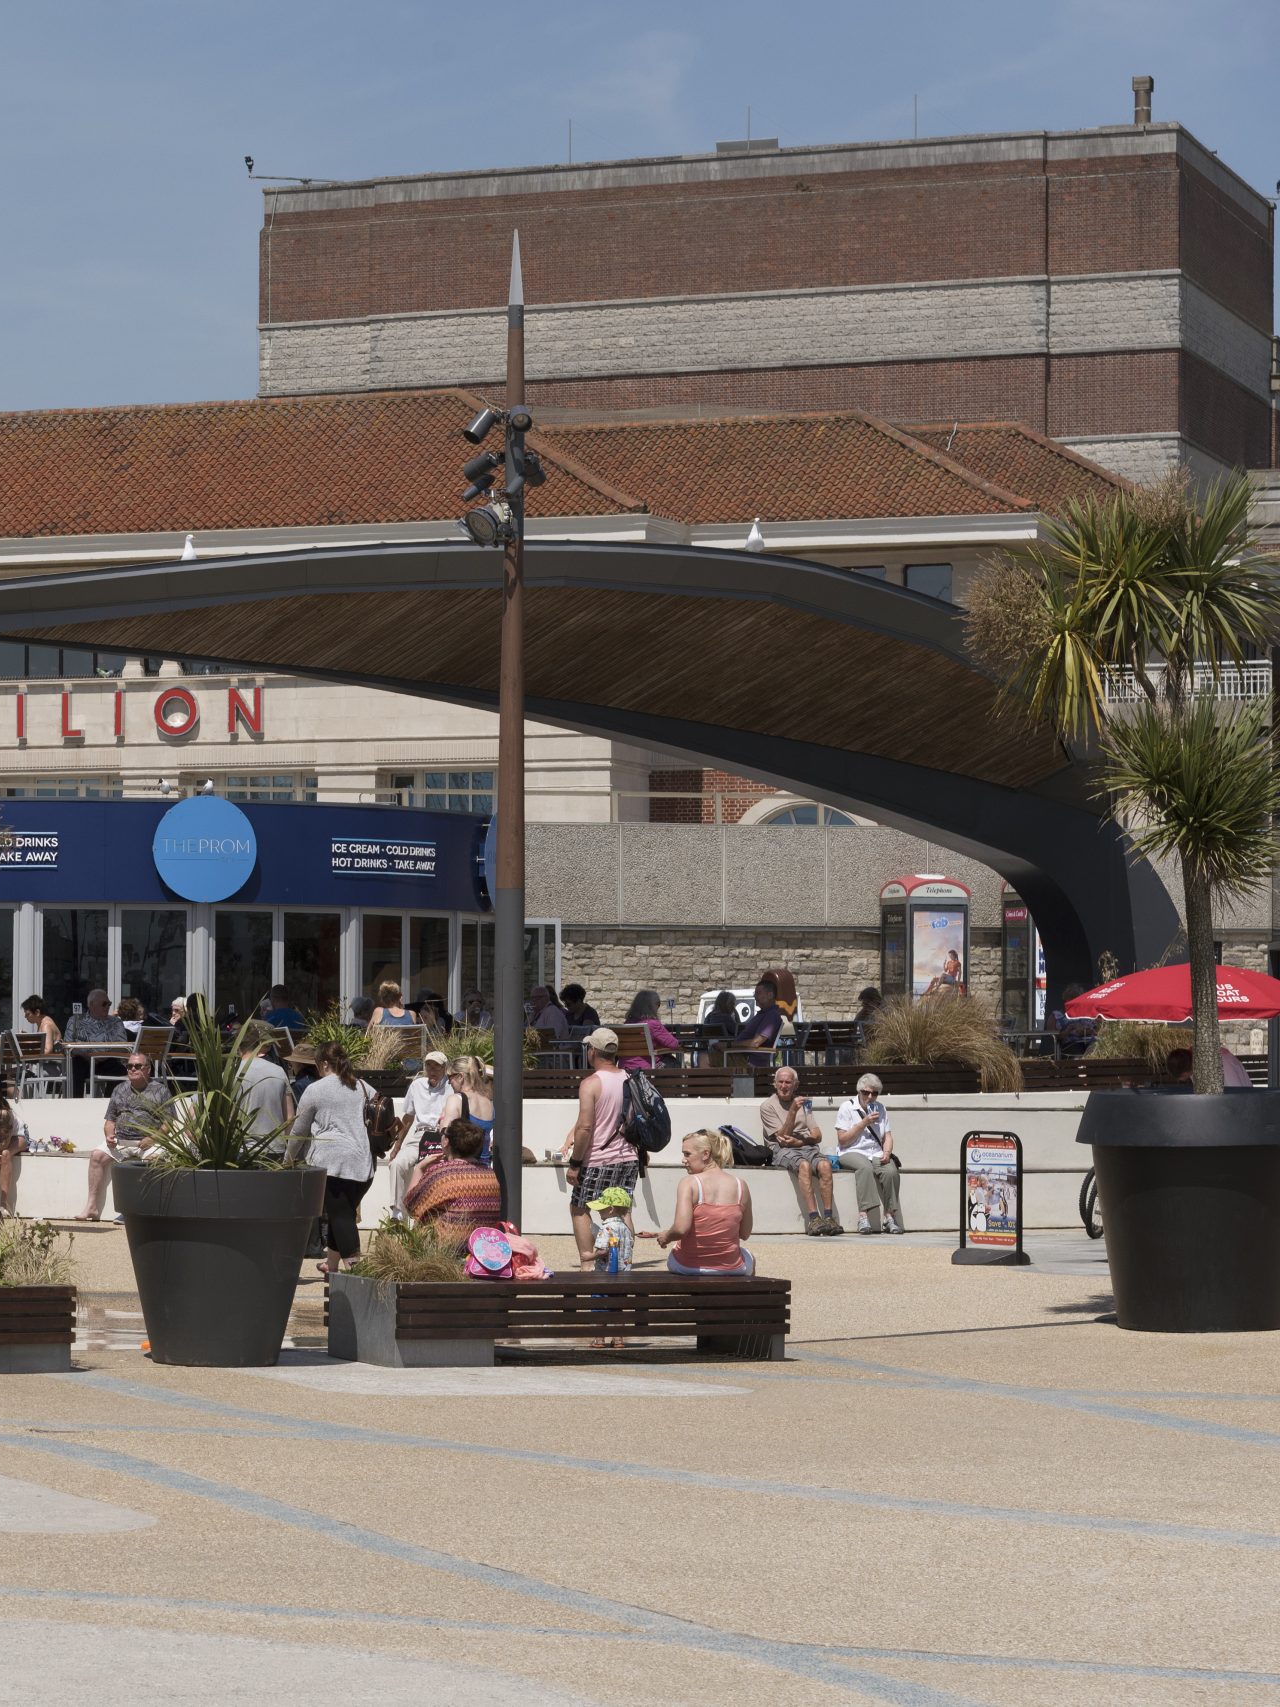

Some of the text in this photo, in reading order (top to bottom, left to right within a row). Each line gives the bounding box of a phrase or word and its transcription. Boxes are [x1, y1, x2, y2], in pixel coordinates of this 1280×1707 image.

[16, 837, 58, 847] DRINKS
[332, 843, 436, 857] ICE CREAM COLD DRINKS
[25, 852, 58, 861] AWAY
[332, 858, 436, 871] HOT DRINKS TAKE AWAY
[926, 886, 953, 895] Telephone
[981, 1151, 1014, 1159] oceanarium
[988, 1220, 1002, 1228] Save
